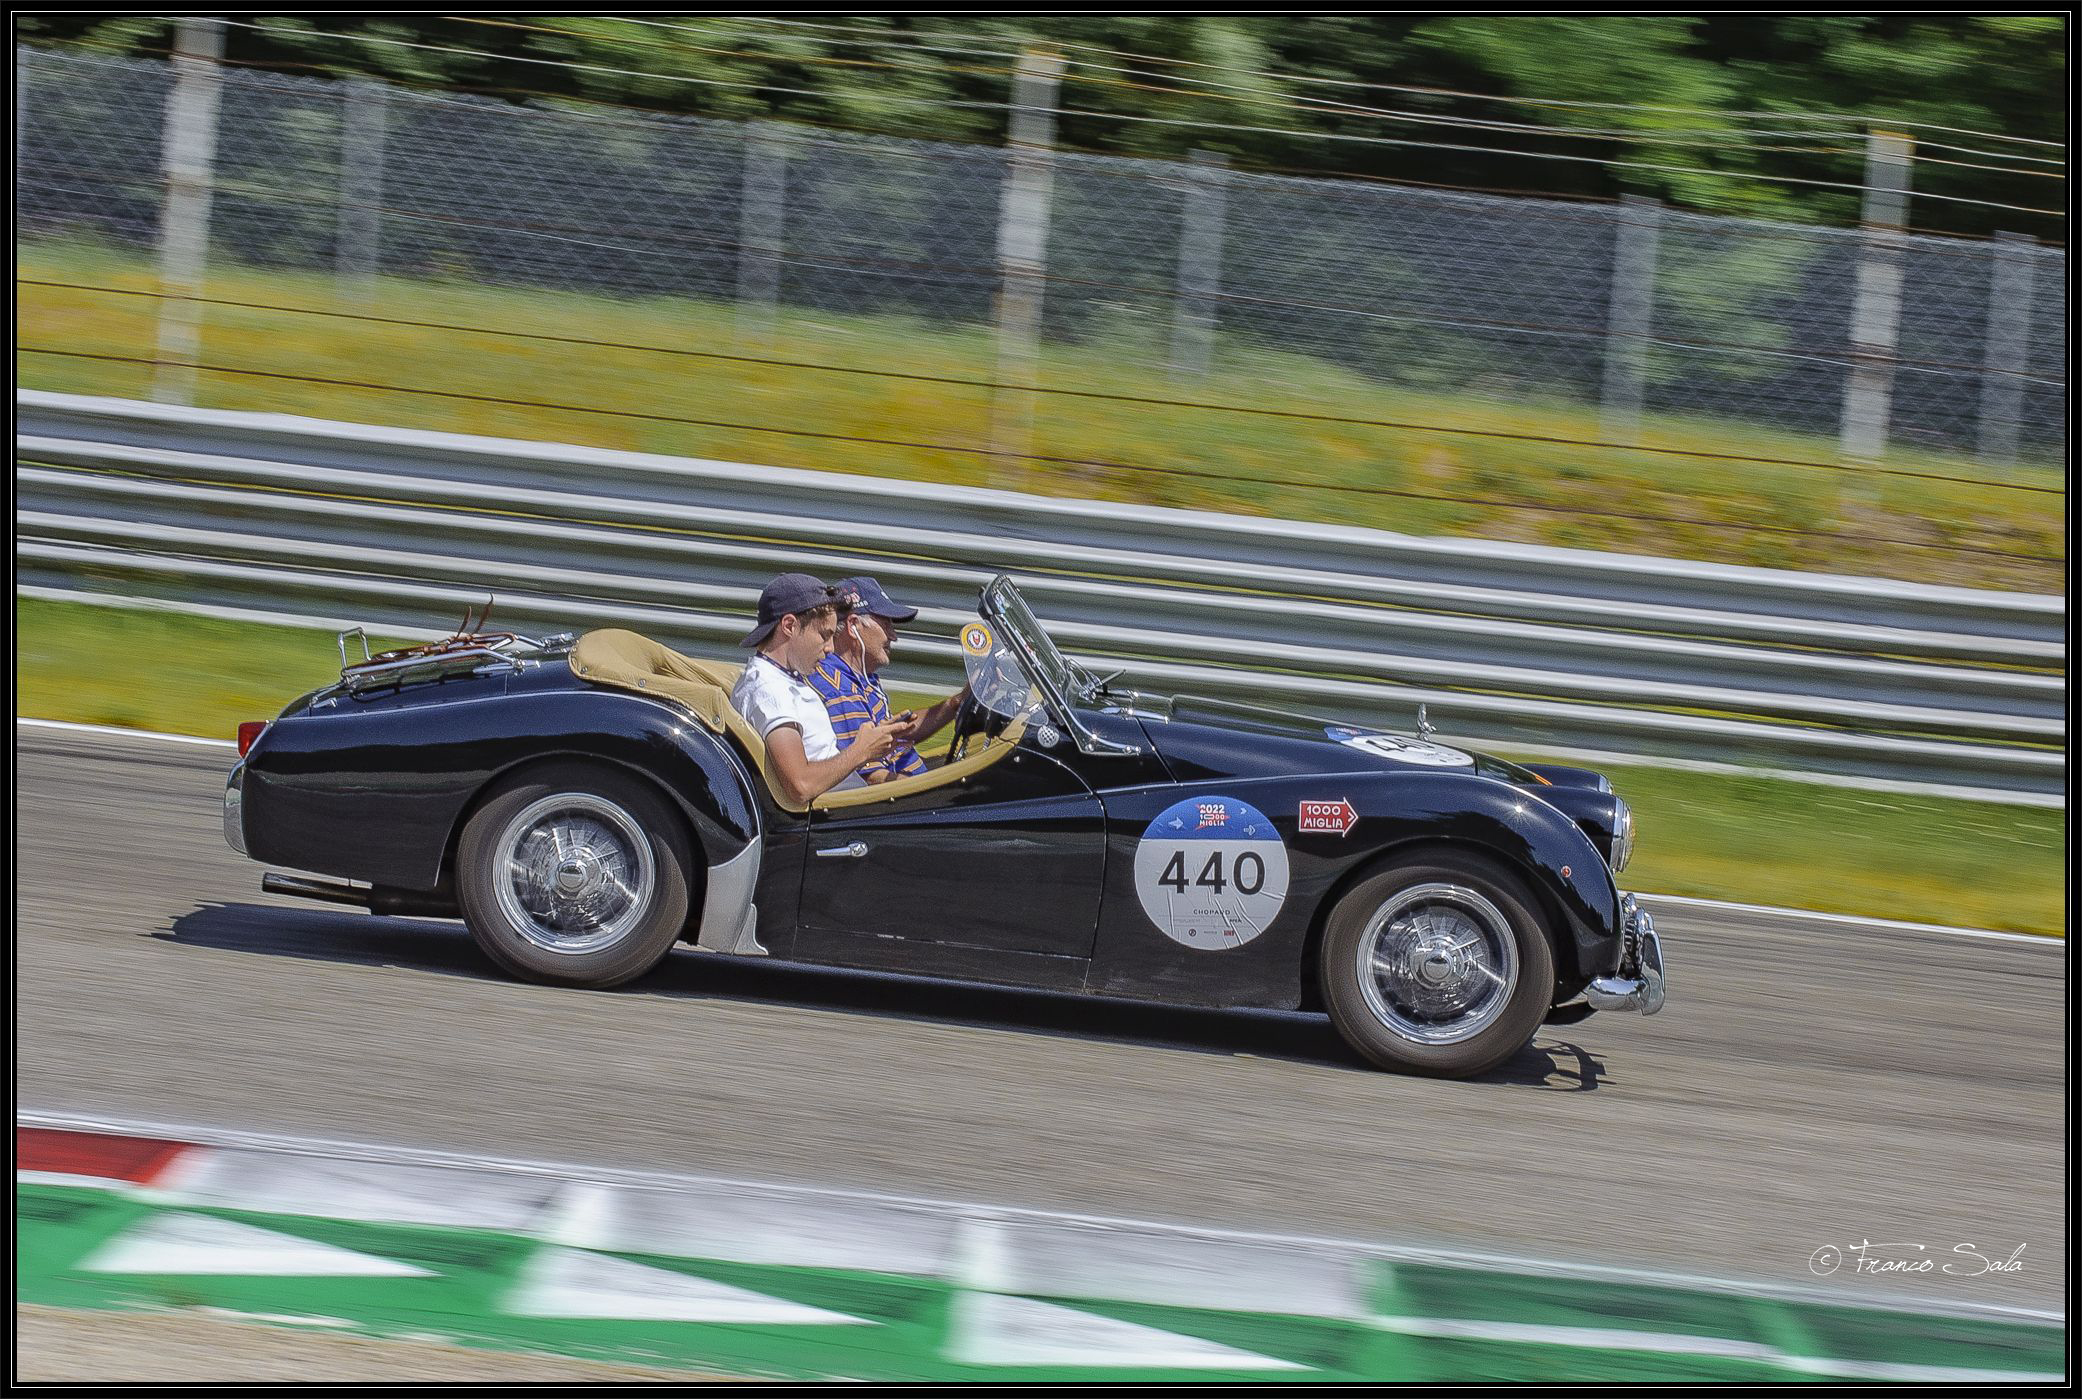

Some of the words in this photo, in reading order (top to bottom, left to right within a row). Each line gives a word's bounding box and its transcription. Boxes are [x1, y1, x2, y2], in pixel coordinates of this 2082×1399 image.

[1199, 803, 1225, 814] 2022
[1306, 804, 1341, 816] 1000
[1199, 819, 1225, 827] MIGLIA
[1303, 816, 1343, 829] MIGLIA
[1158, 850, 1266, 895] 440
